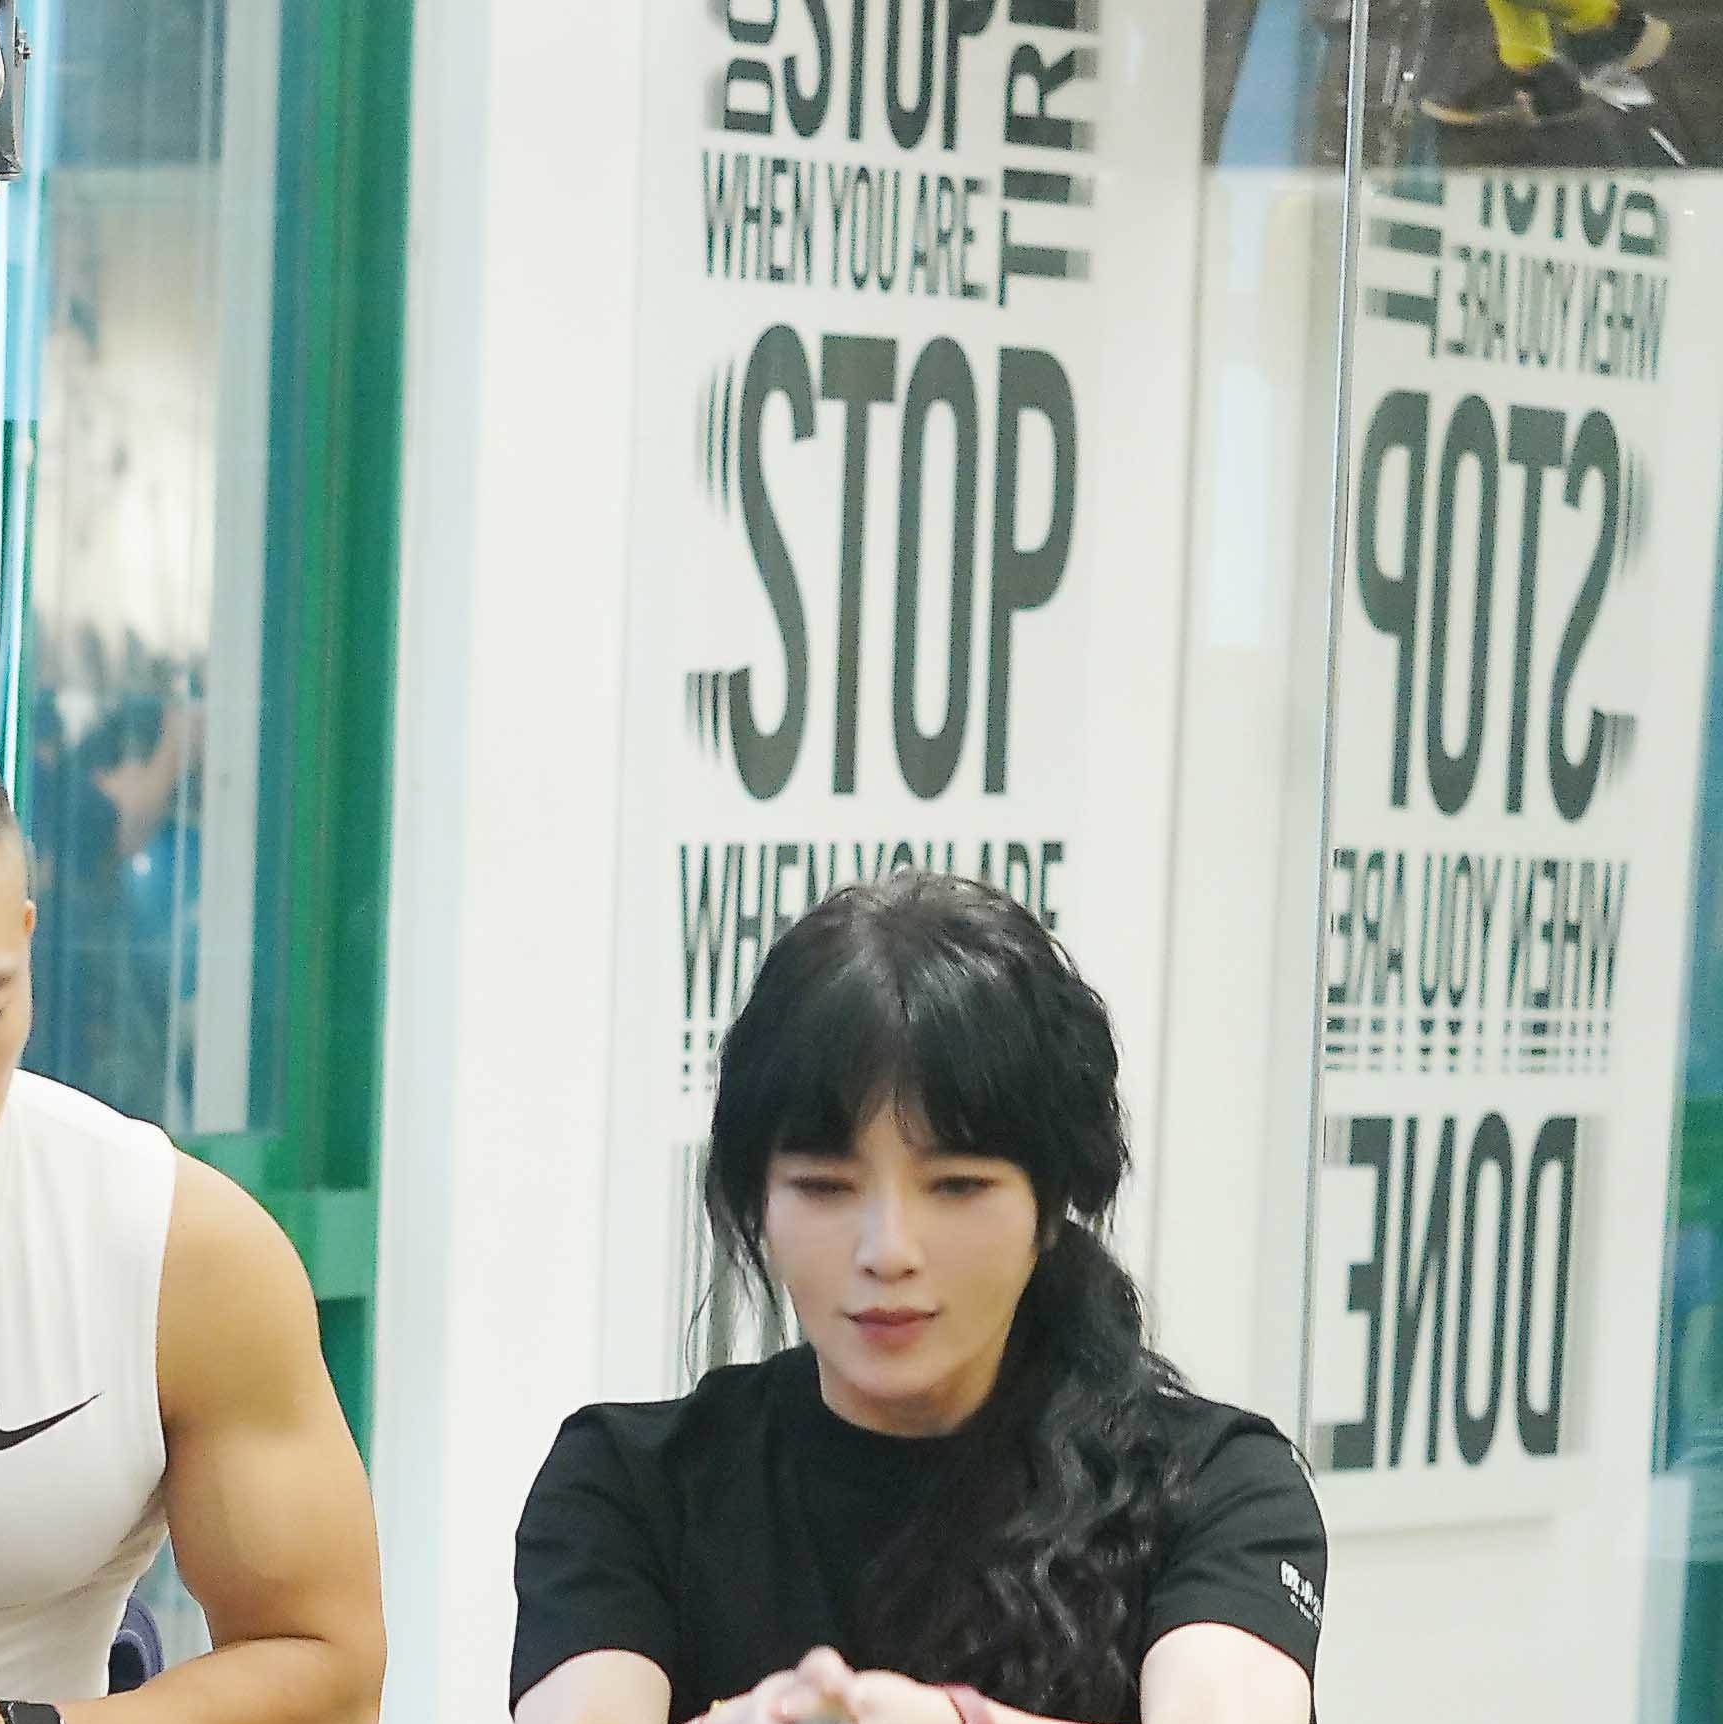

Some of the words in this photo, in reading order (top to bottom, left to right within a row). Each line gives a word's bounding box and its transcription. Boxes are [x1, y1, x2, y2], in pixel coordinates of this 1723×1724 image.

[702, 149, 817, 287] WHEN
[827, 160, 902, 294] YOU
[906, 172, 989, 301] ARE
[727, 321, 1079, 801] STOP
